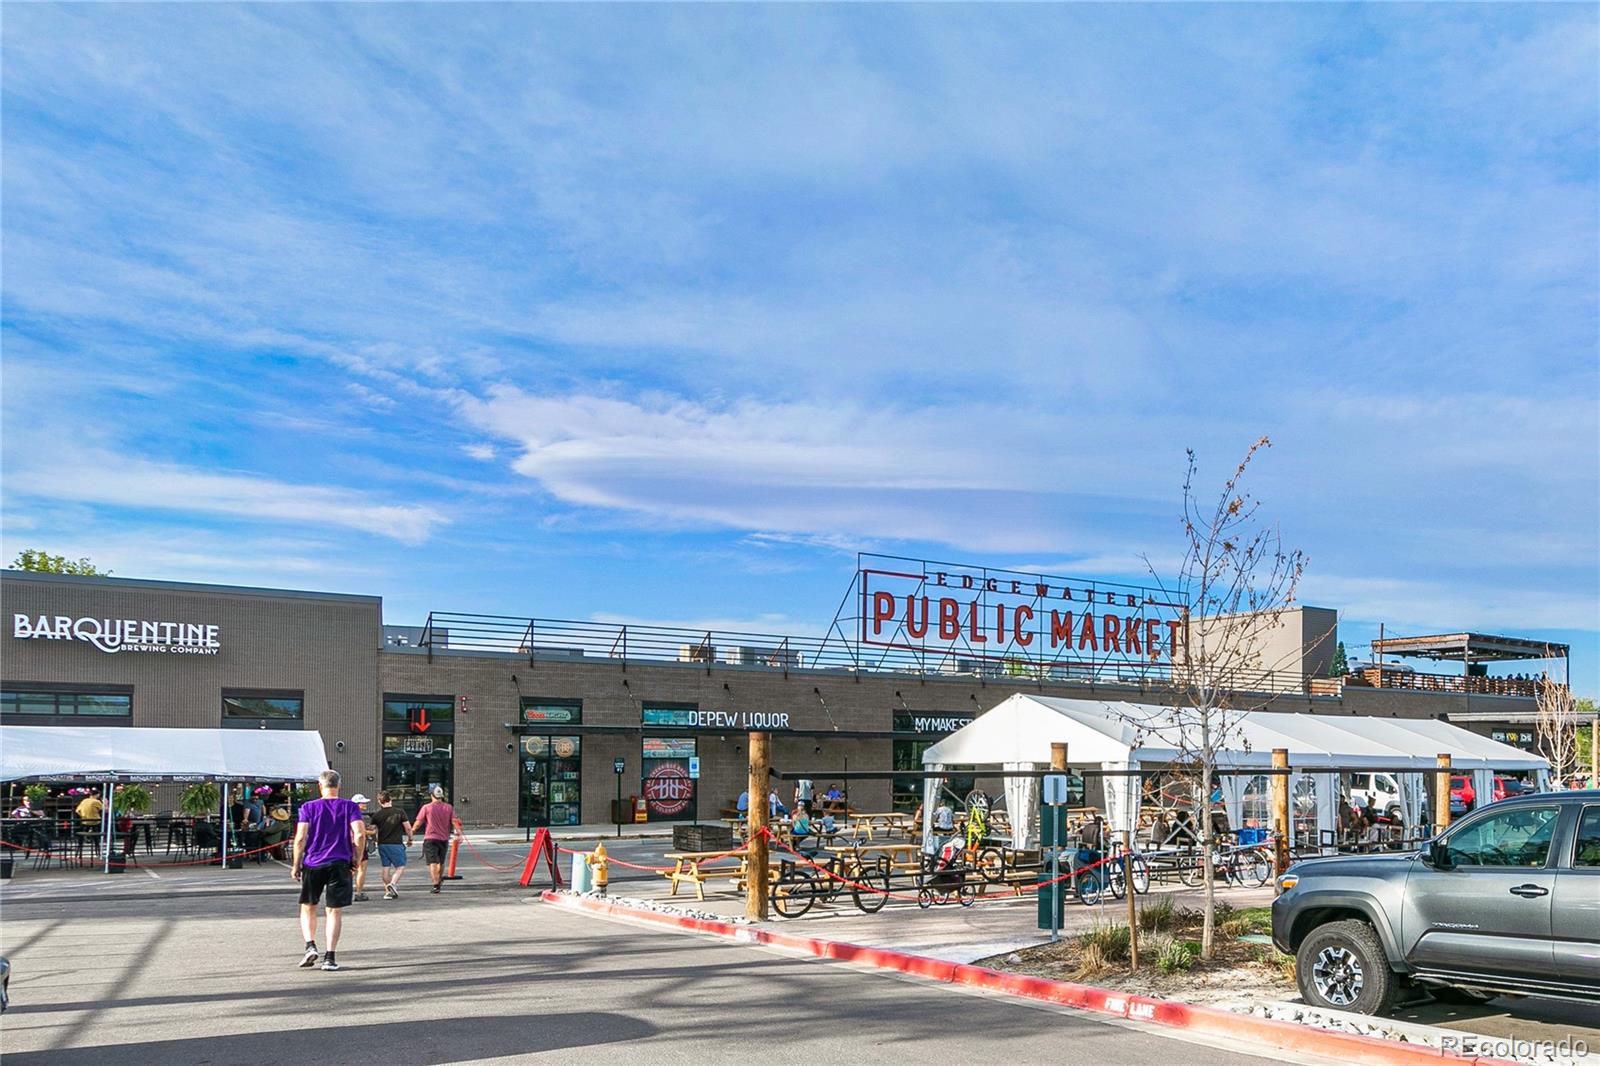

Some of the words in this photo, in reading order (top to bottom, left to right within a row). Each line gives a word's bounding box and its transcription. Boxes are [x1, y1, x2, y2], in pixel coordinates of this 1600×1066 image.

[936, 572, 1137, 607] EDGEWATER
[14, 614, 220, 653] BARQUENTINE
[873, 591, 1034, 646] PUBLIC
[1051, 609, 1181, 657] MARKET
[121, 644, 167, 653] BREWING
[170, 646, 218, 655] COMPANY
[689, 711, 738, 726] DEPEW
[742, 712, 789, 728] LIQUOR
[1130, 1002, 1156, 1018] LANE
